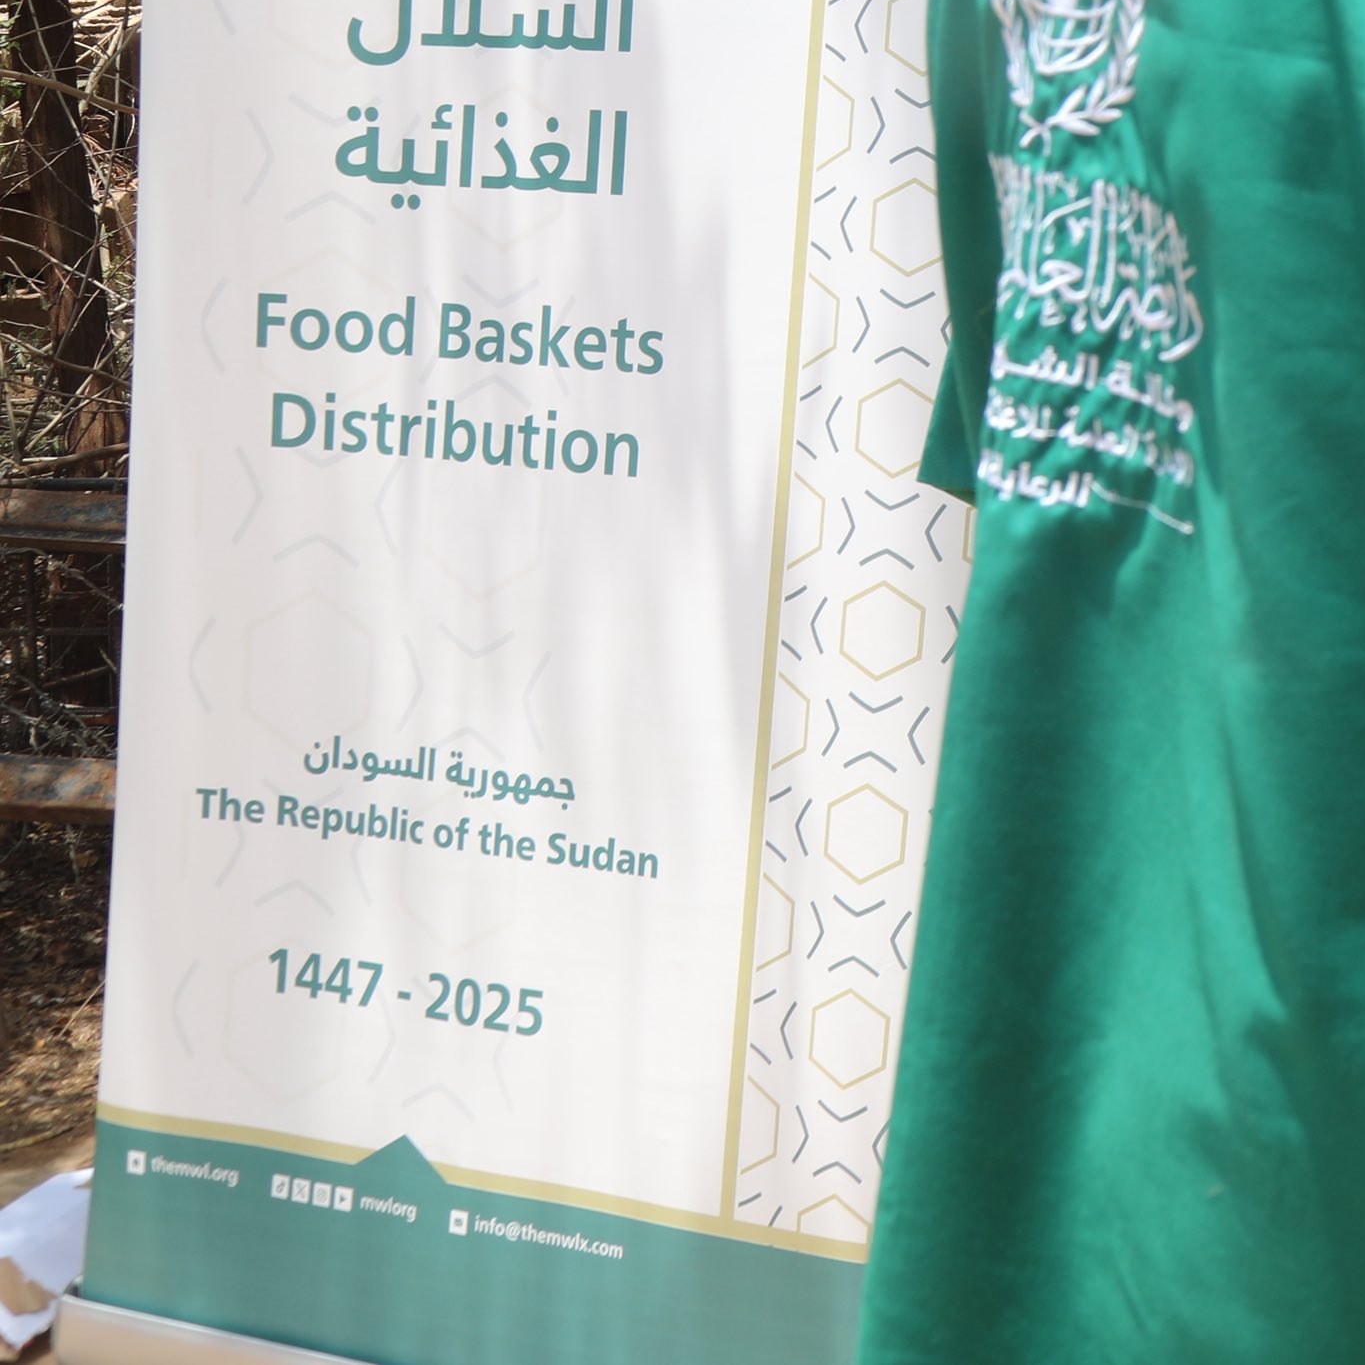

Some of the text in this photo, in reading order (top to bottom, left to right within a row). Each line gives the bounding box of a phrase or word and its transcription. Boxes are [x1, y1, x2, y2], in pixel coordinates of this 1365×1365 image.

[334, 103, 628, 210] الغذائية
[255, 292, 665, 375] Food Baskets
[270, 391, 640, 478] Distribution
[303, 735, 576, 811] جمهورية السودان
[196, 788, 660, 879] The Republic of the Sudan
[268, 948, 544, 1037] 1447 - 2025
[151, 1155, 240, 1187] themwl.org
[360, 1194, 418, 1223] mwlorg
[474, 1214, 624, 1259] info@themwlx.com
